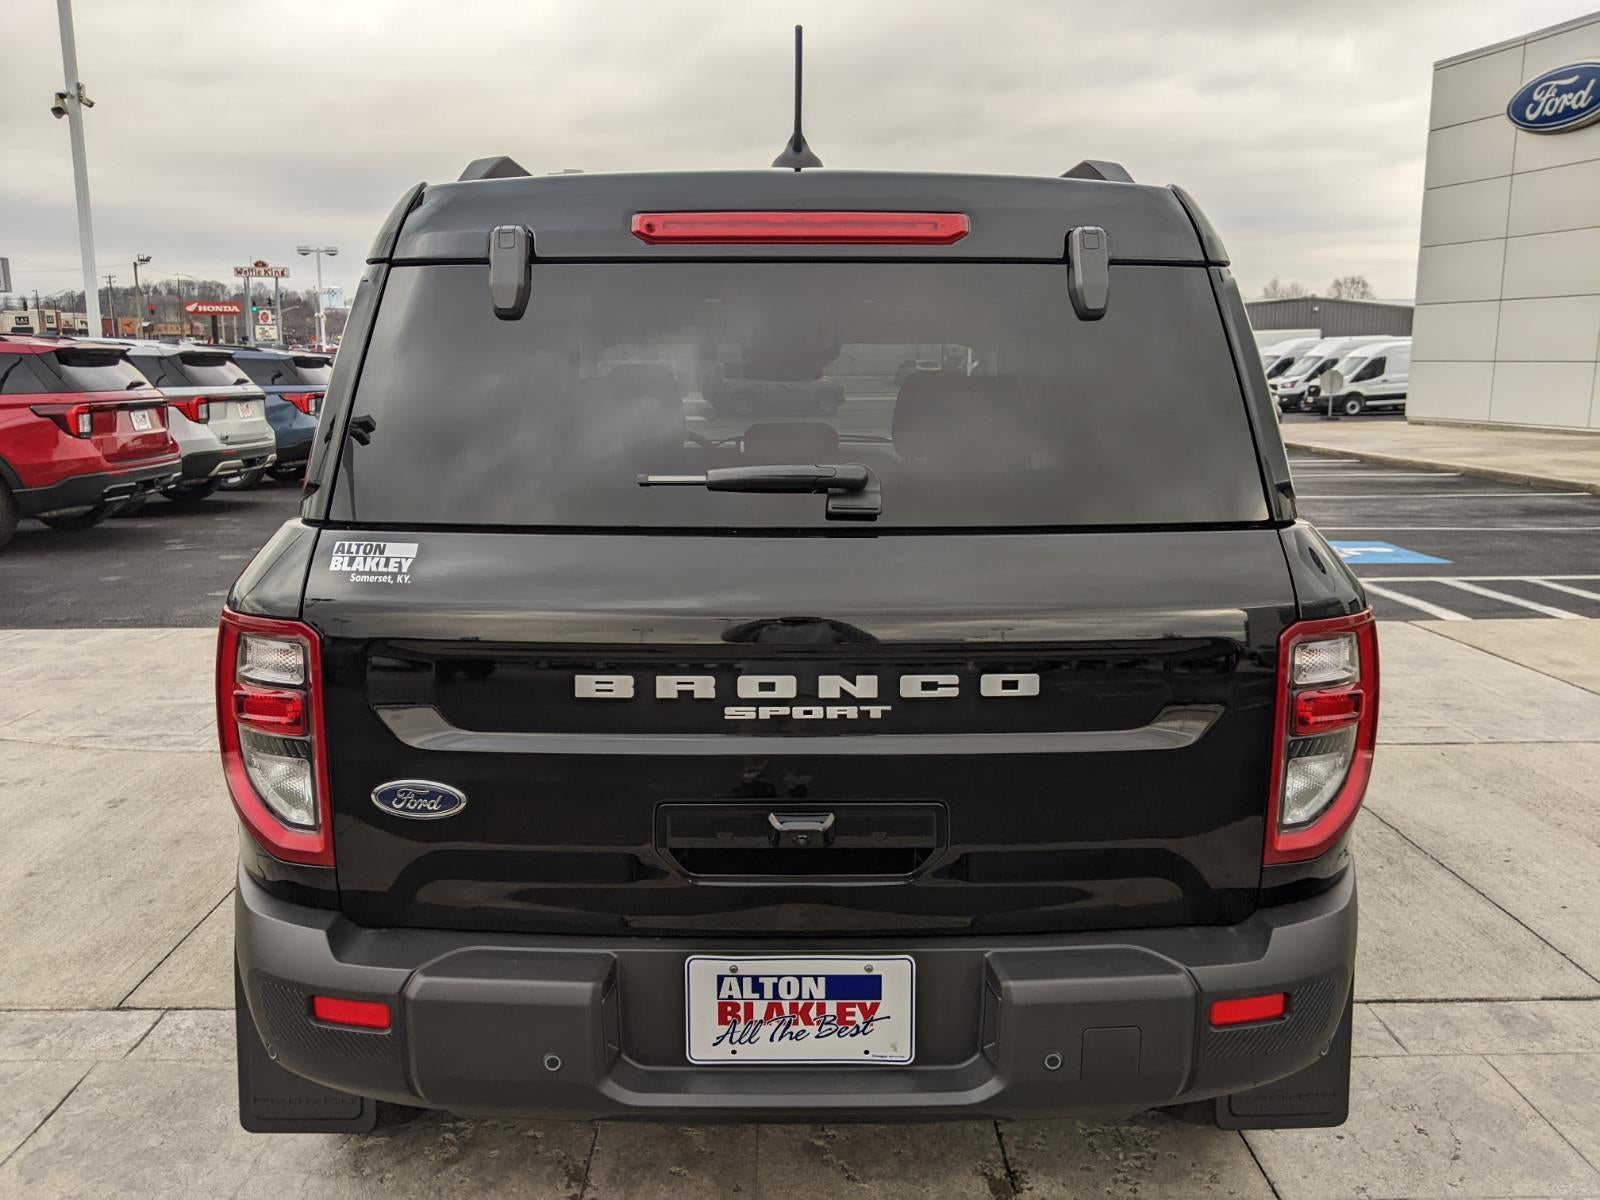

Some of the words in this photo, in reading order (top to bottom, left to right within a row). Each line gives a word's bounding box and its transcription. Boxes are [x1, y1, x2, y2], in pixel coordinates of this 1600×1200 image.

[1526, 75, 1597, 120] Ford
[264, 267, 286, 277] King
[334, 542, 387, 555] ALTON
[329, 557, 416, 572] BLAKLEY
[350, 573, 394, 584] Somerset,
[396, 574, 411, 583] KY.
[574, 673, 1041, 699] BRONCO
[723, 705, 892, 720] SPORT
[392, 788, 442, 811] Ford
[718, 976, 826, 1000] ALTON
[718, 1002, 881, 1026] BLAKLEY
[712, 1018, 764, 1047] All
[767, 1014, 811, 1043] The
[813, 1014, 891, 1039] Best
